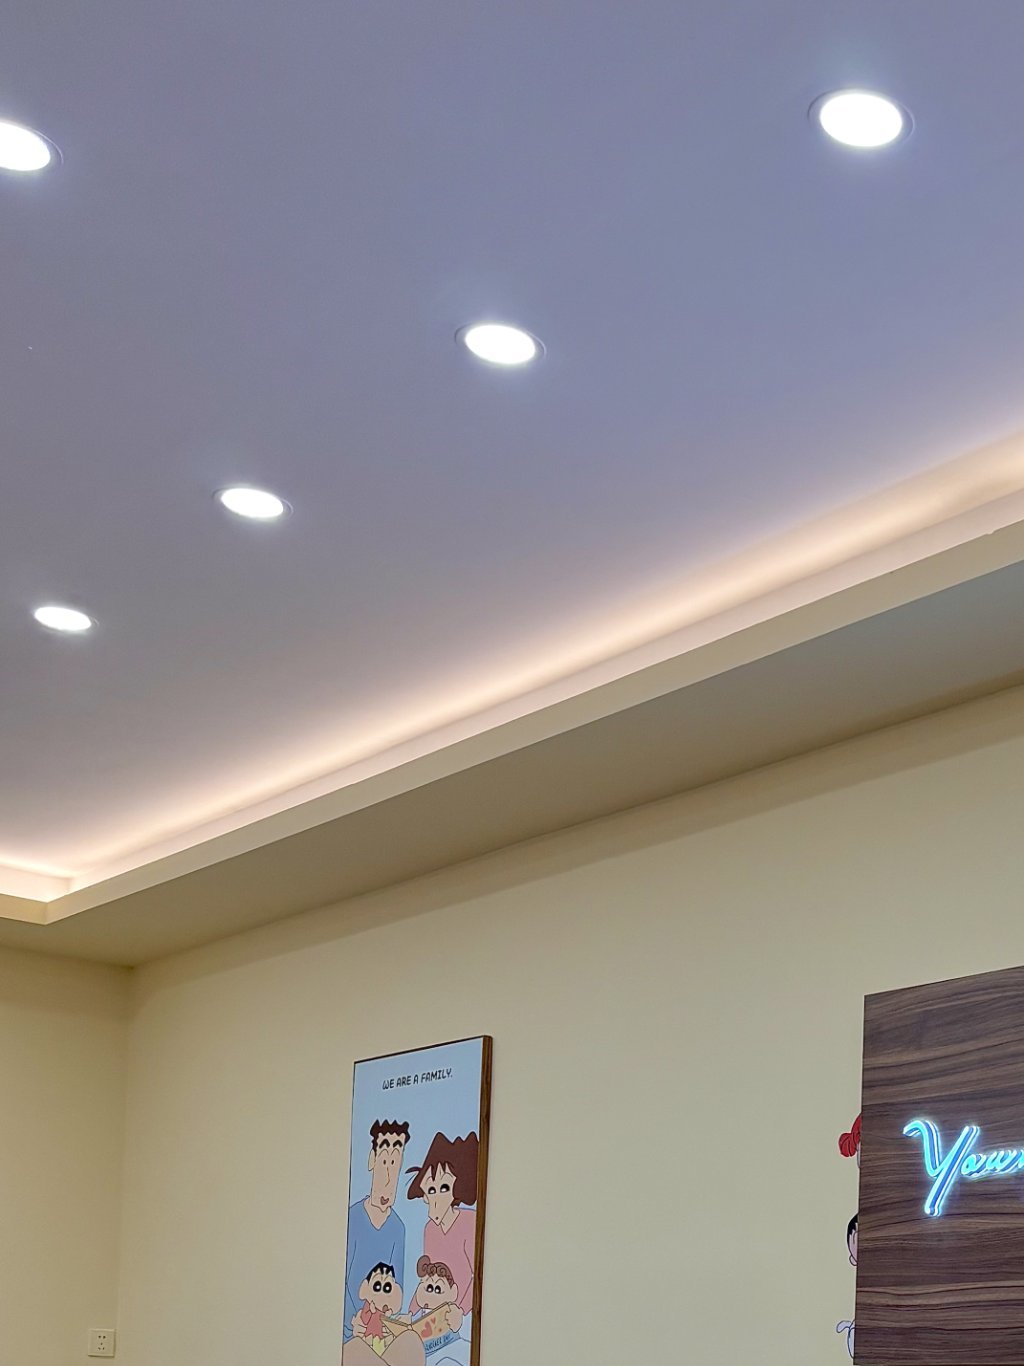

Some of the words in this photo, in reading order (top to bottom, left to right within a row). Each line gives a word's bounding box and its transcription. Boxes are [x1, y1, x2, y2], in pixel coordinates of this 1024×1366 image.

[382, 1079, 395, 1090] WE
[396, 1075, 412, 1087] ARE
[413, 1074, 419, 1085] A
[420, 1067, 453, 1083] FAMILY.
